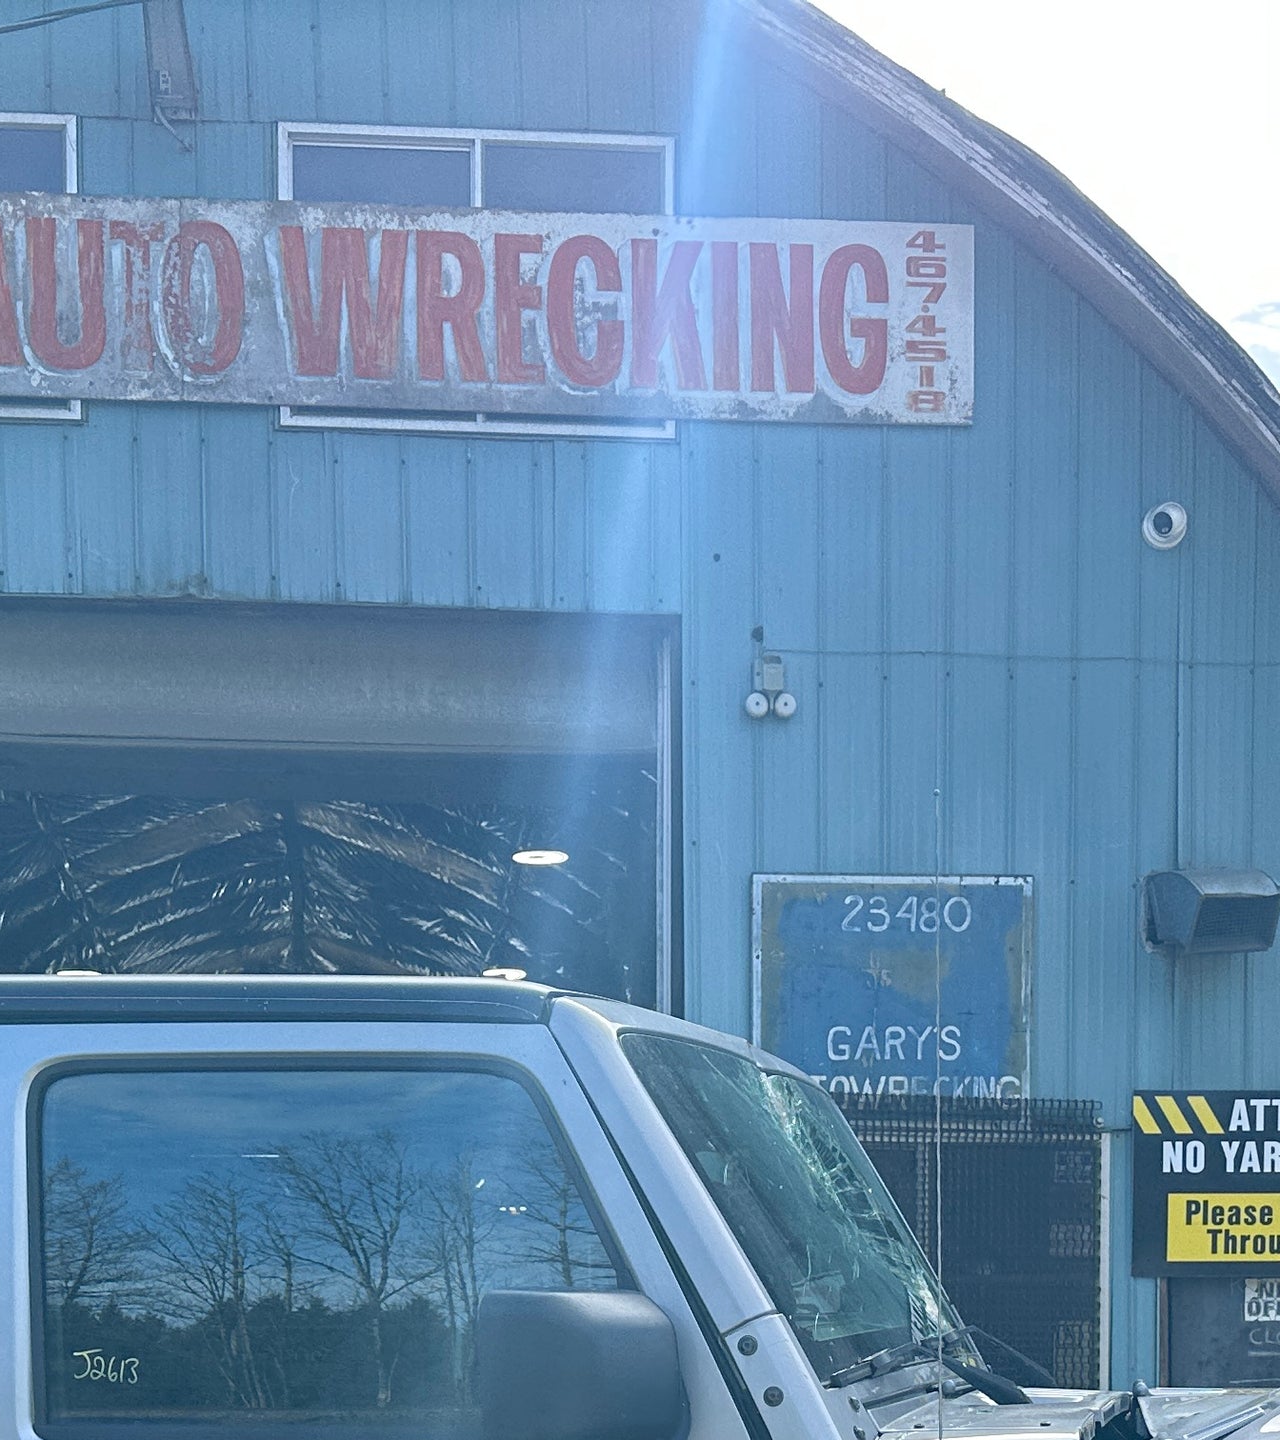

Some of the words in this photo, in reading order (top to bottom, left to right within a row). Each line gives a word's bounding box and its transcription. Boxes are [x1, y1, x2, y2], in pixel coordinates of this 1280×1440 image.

[281, 225, 890, 396] WRECKING
[841, 895, 972, 932] 23480
[827, 1026, 962, 1061] GARY'S
[1161, 1140, 1206, 1174] NO
[1185, 1199, 1274, 1226] Please
[72, 1348, 140, 1384] J2613
